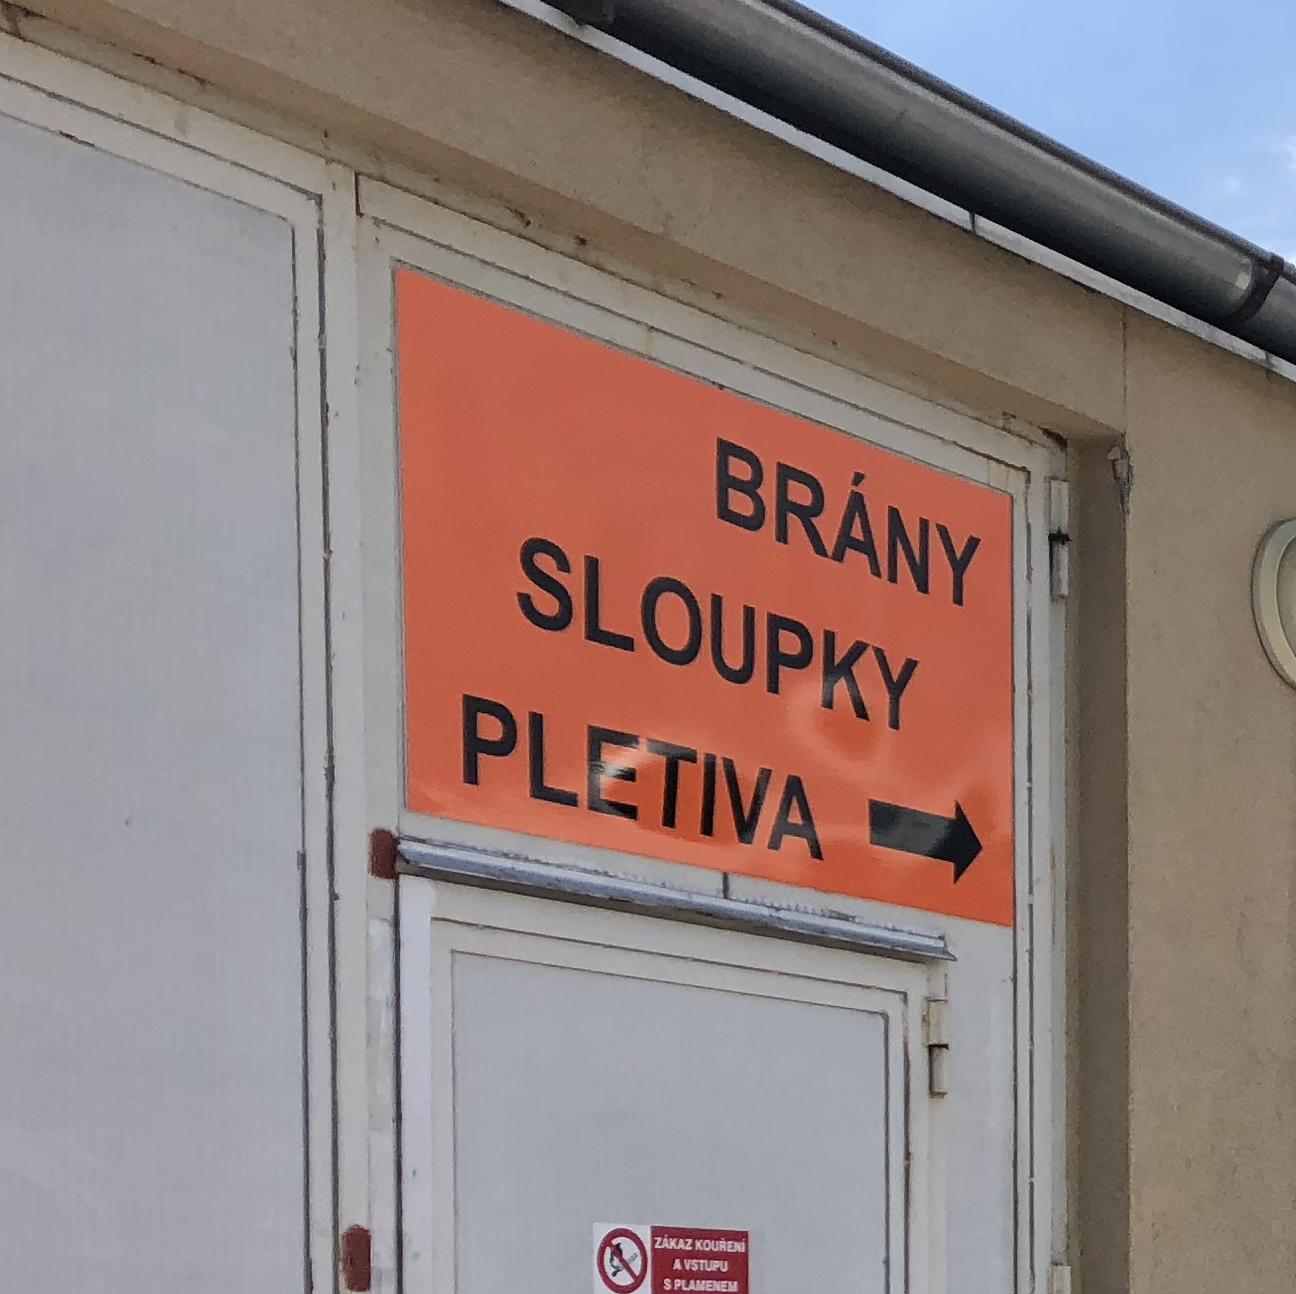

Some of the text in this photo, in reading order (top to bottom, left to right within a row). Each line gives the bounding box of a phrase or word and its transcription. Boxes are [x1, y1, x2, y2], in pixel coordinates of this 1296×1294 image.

[715, 436, 981, 606] BRÁNY
[516, 536, 919, 732] SLOUPKY
[461, 693, 824, 862] PLETIVA
[653, 1234, 746, 1253] ZÁKAZ KOUŘENÍ
[663, 1278, 739, 1292] S PLAMENEM
[672, 1259, 728, 1273] A VSTUPU
